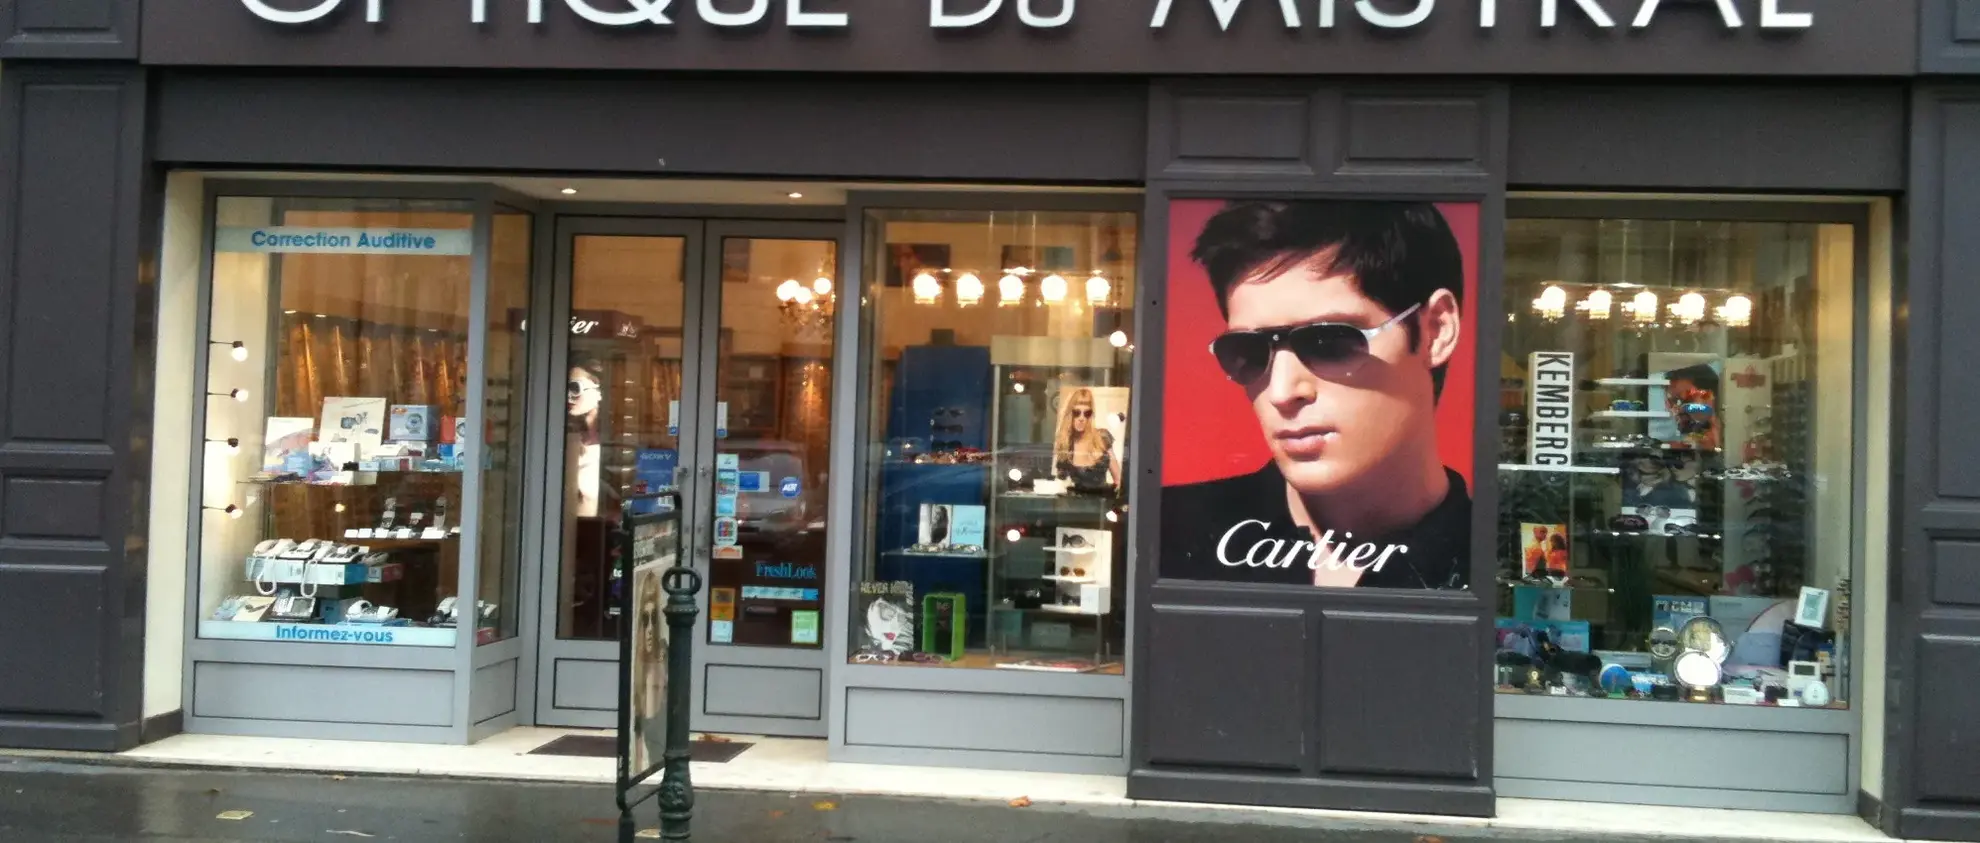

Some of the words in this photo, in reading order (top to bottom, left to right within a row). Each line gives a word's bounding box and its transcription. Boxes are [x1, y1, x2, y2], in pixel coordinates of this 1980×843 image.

[252, 231, 350, 247] Correction
[357, 232, 436, 249] Auditive
[1535, 354, 1570, 465] KEMBERG
[1216, 519, 1408, 572] Cartier
[756, 563, 817, 579] FreshLook
[276, 625, 394, 642] Informez-vous
